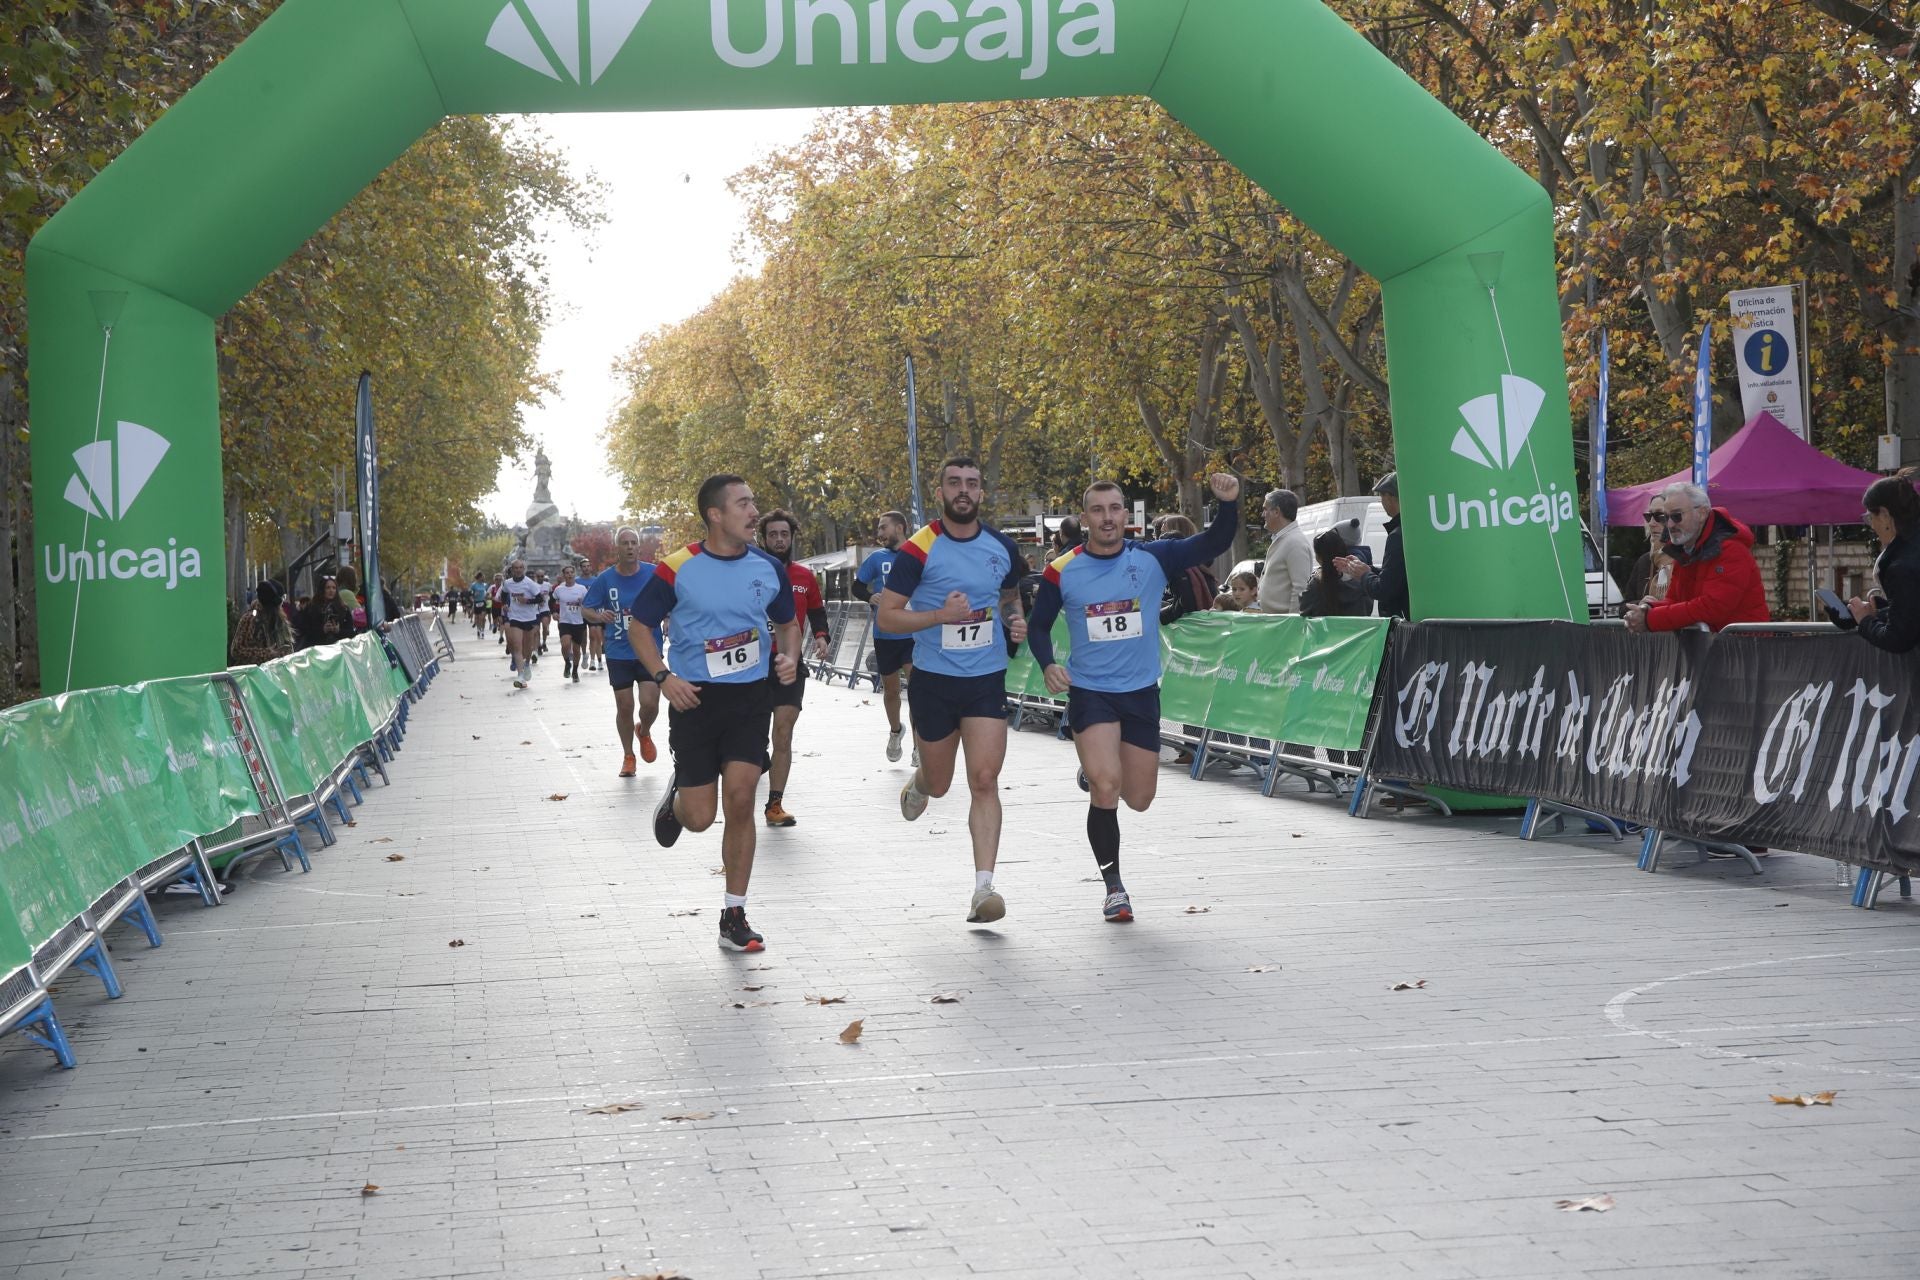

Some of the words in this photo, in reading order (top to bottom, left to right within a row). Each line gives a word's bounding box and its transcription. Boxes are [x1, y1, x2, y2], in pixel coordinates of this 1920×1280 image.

[710, 0, 1116, 80] Unicaja
[1737, 297, 1764, 307] Oficina
[1765, 296, 1775, 304] de
[1429, 482, 1574, 533] Unicaja
[45, 537, 201, 590] Unicaja
[957, 625, 981, 642] 17
[1102, 616, 1128, 633] 18
[722, 647, 747, 666] 16
[1395, 660, 1449, 753] El
[1448, 660, 1556, 761] Norte
[1753, 680, 1834, 805] El
